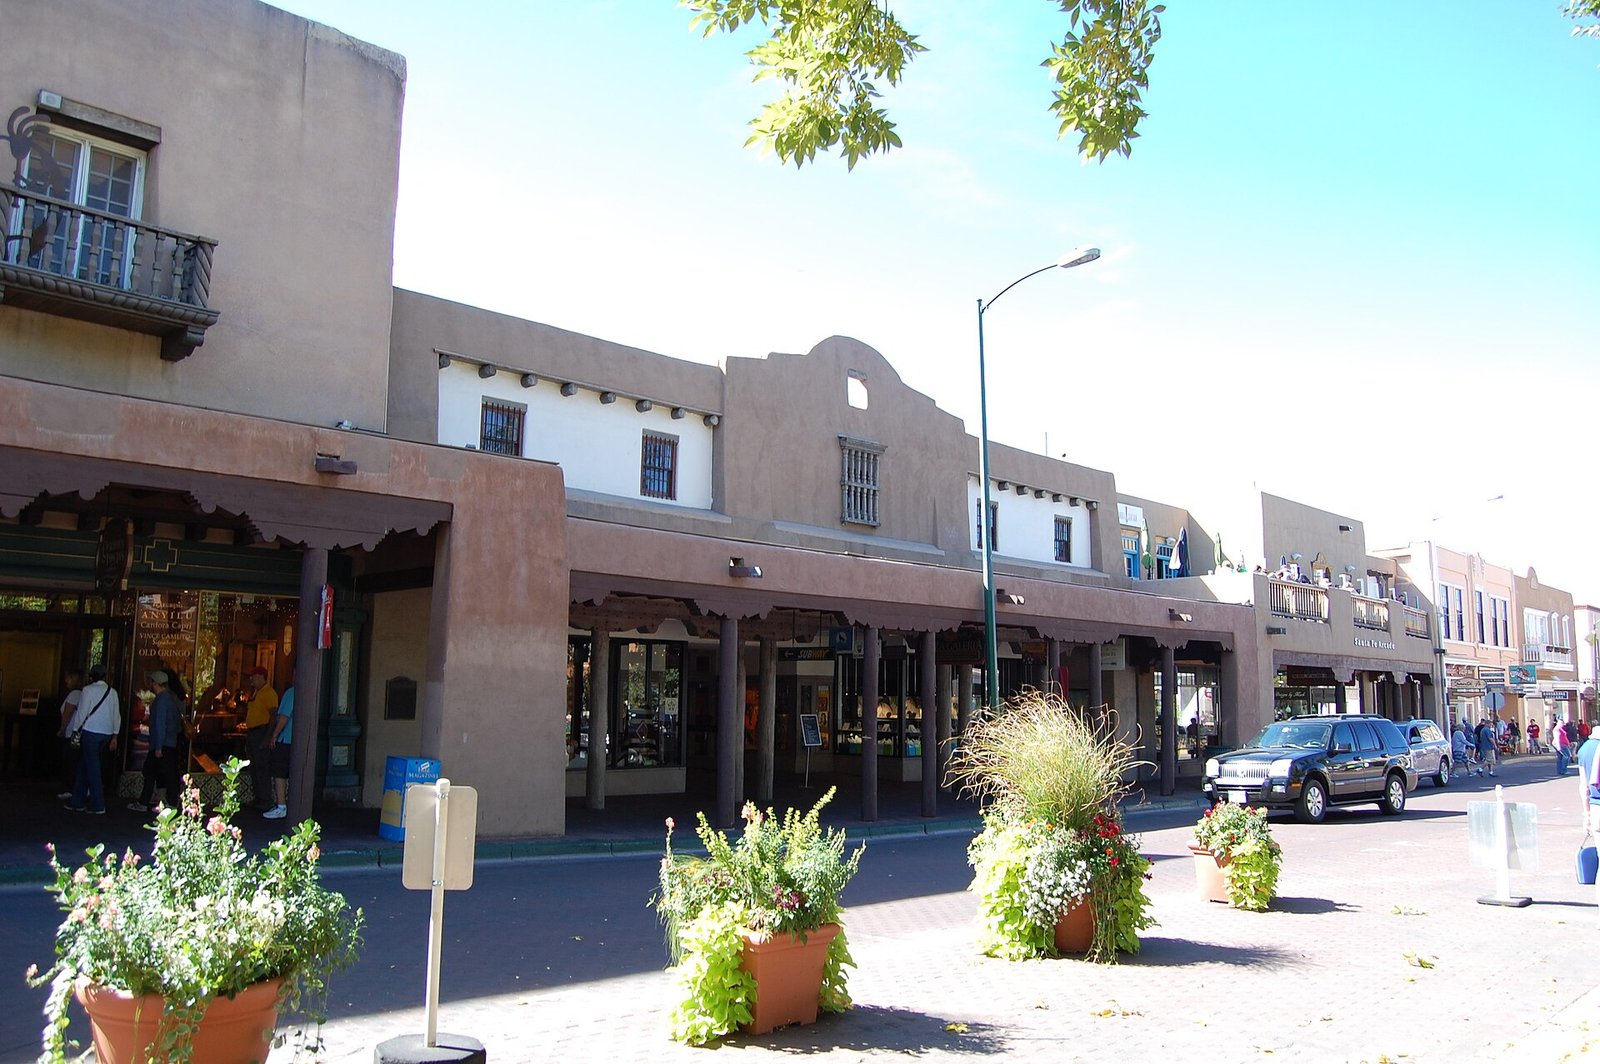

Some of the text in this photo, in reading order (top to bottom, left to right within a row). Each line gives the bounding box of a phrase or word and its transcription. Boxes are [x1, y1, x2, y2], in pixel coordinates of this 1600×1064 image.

[1354, 637, 1395, 650] Santa Fe Arcade
[138, 648, 191, 657] OLD GRINGO
[798, 648, 829, 659] SUBWAY
